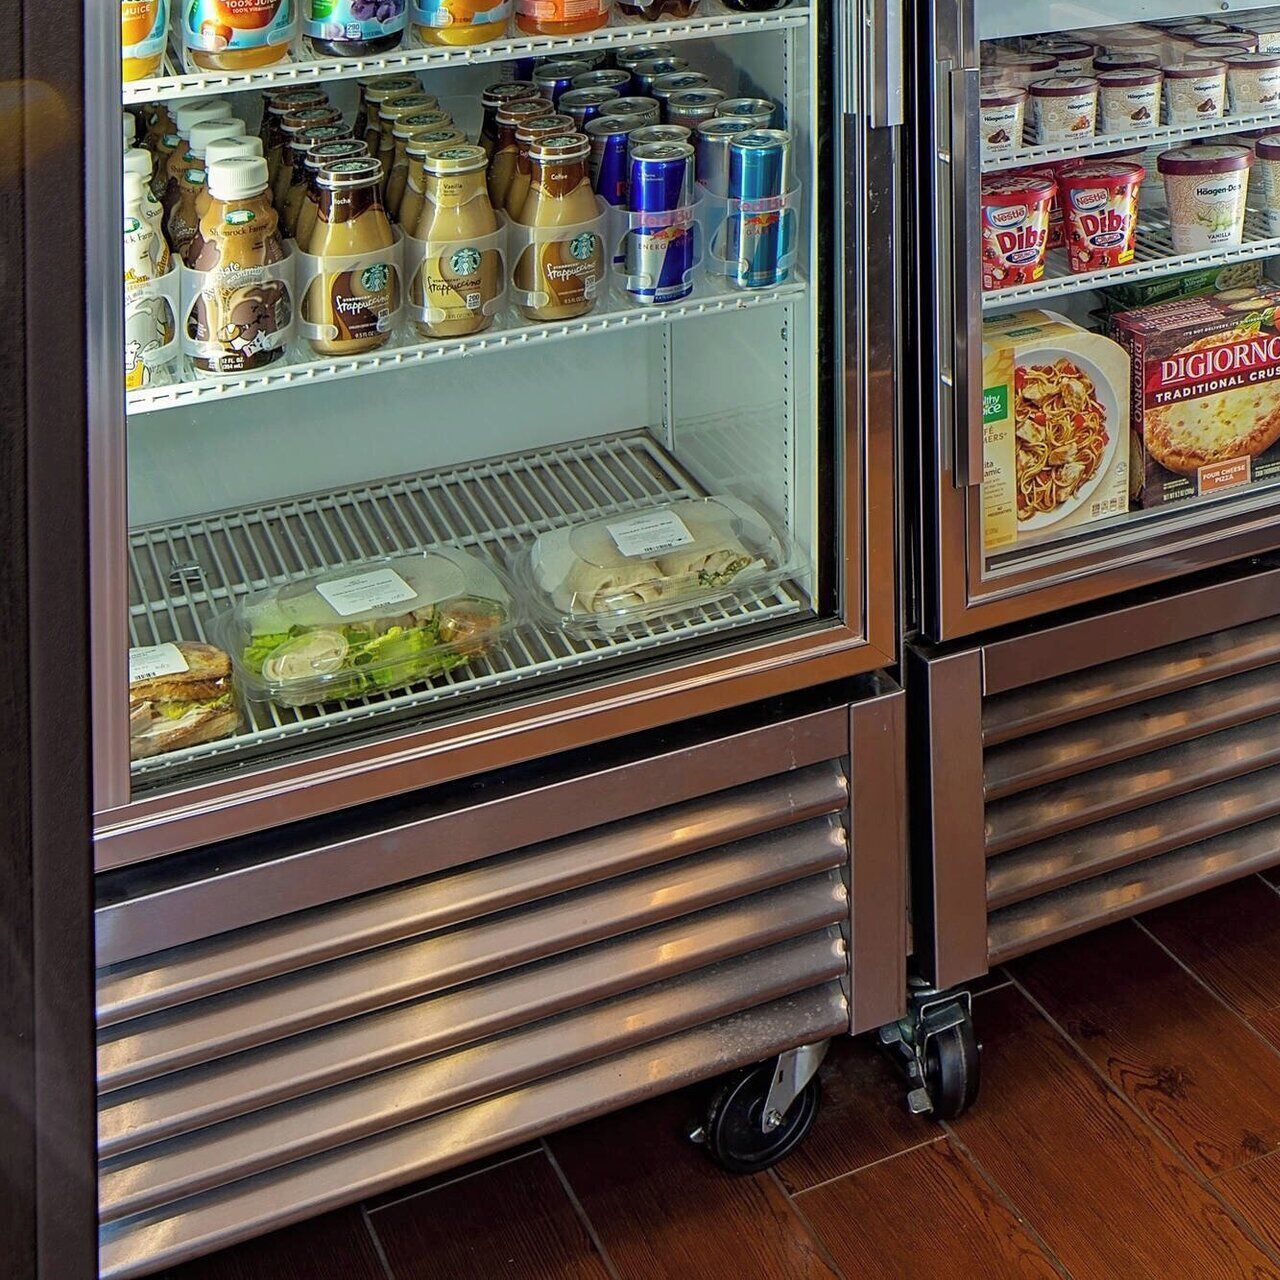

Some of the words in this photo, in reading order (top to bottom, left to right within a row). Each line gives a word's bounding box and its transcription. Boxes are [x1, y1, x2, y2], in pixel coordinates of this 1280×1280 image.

[226, 0, 252, 8] 100%
[1079, 209, 1131, 236] Dibs
[996, 226, 1047, 254] Dibs
[1207, 231, 1232, 240] VANILLA
[1155, 375, 1245, 404] TRADITIONAL
[1214, 474, 1234, 484] PIZZA
